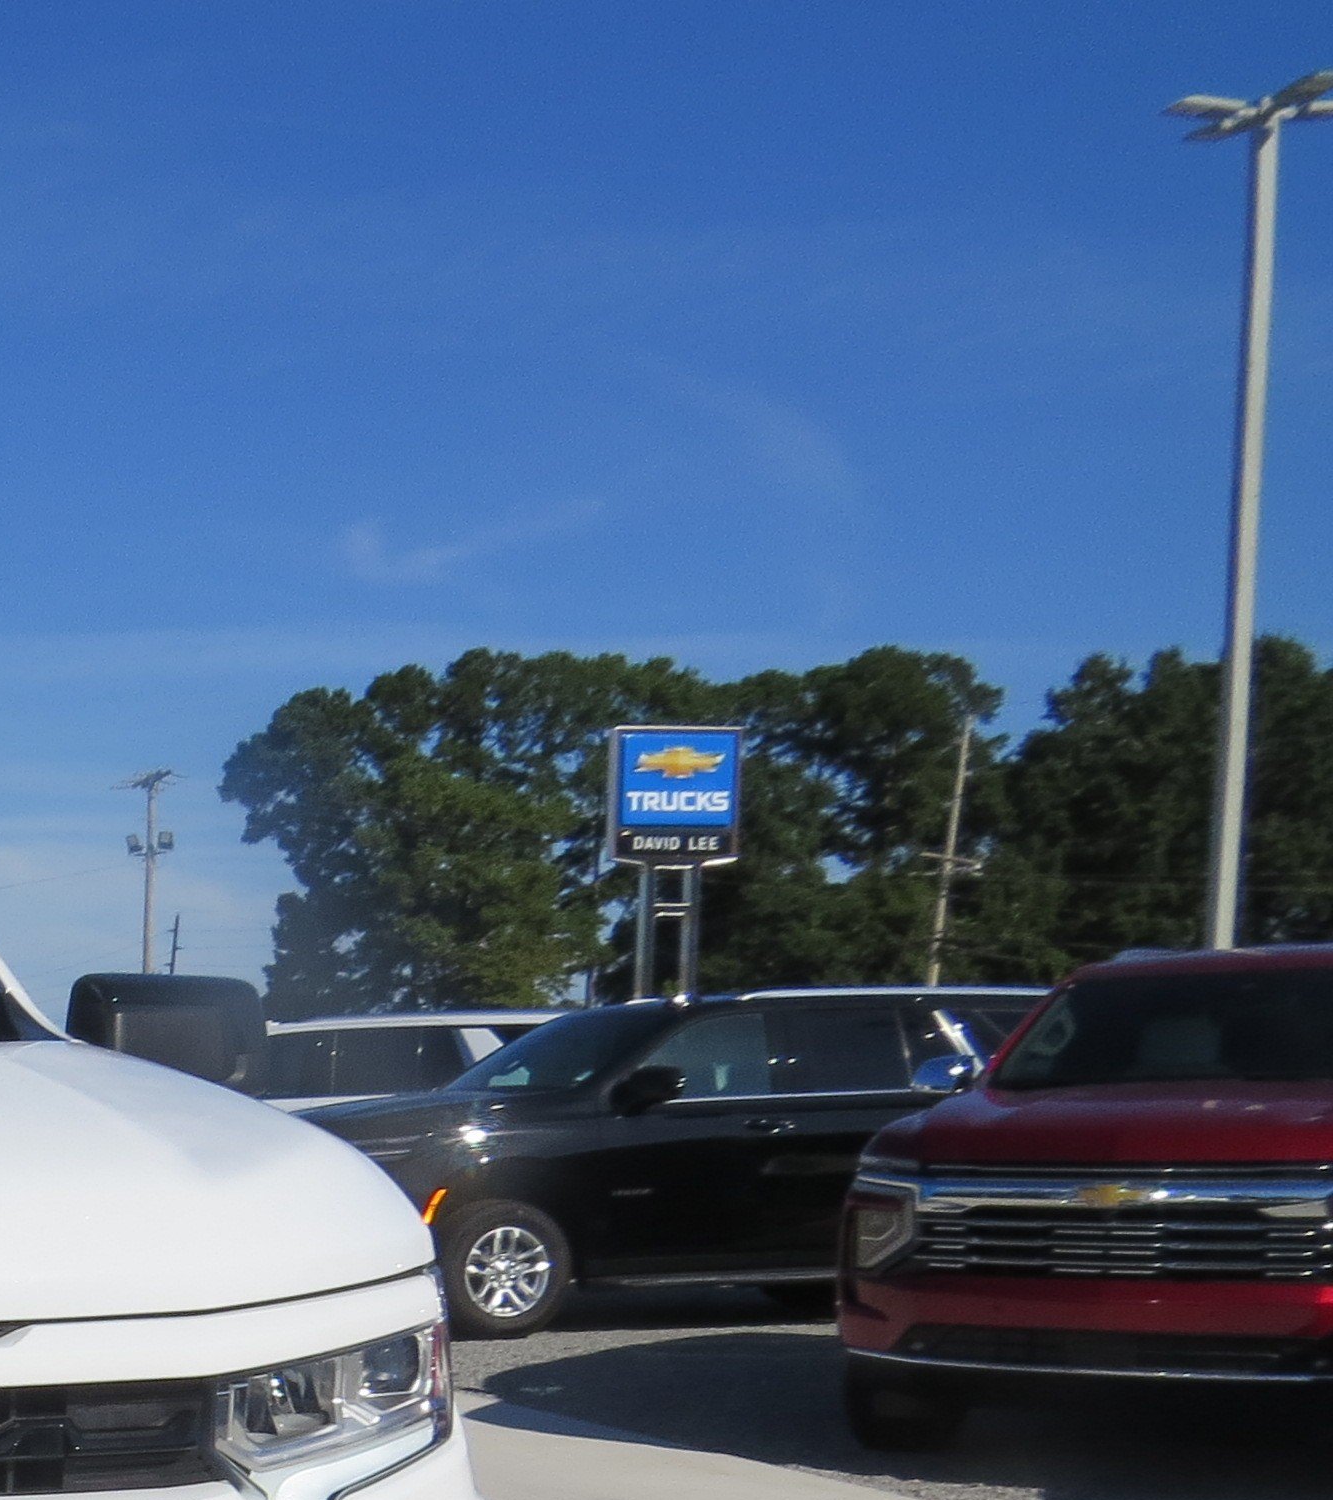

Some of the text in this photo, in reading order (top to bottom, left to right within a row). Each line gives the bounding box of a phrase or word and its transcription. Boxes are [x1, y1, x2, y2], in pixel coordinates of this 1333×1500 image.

[626, 790, 730, 812] TRUCKS
[633, 836, 719, 851] DAVID LEE
